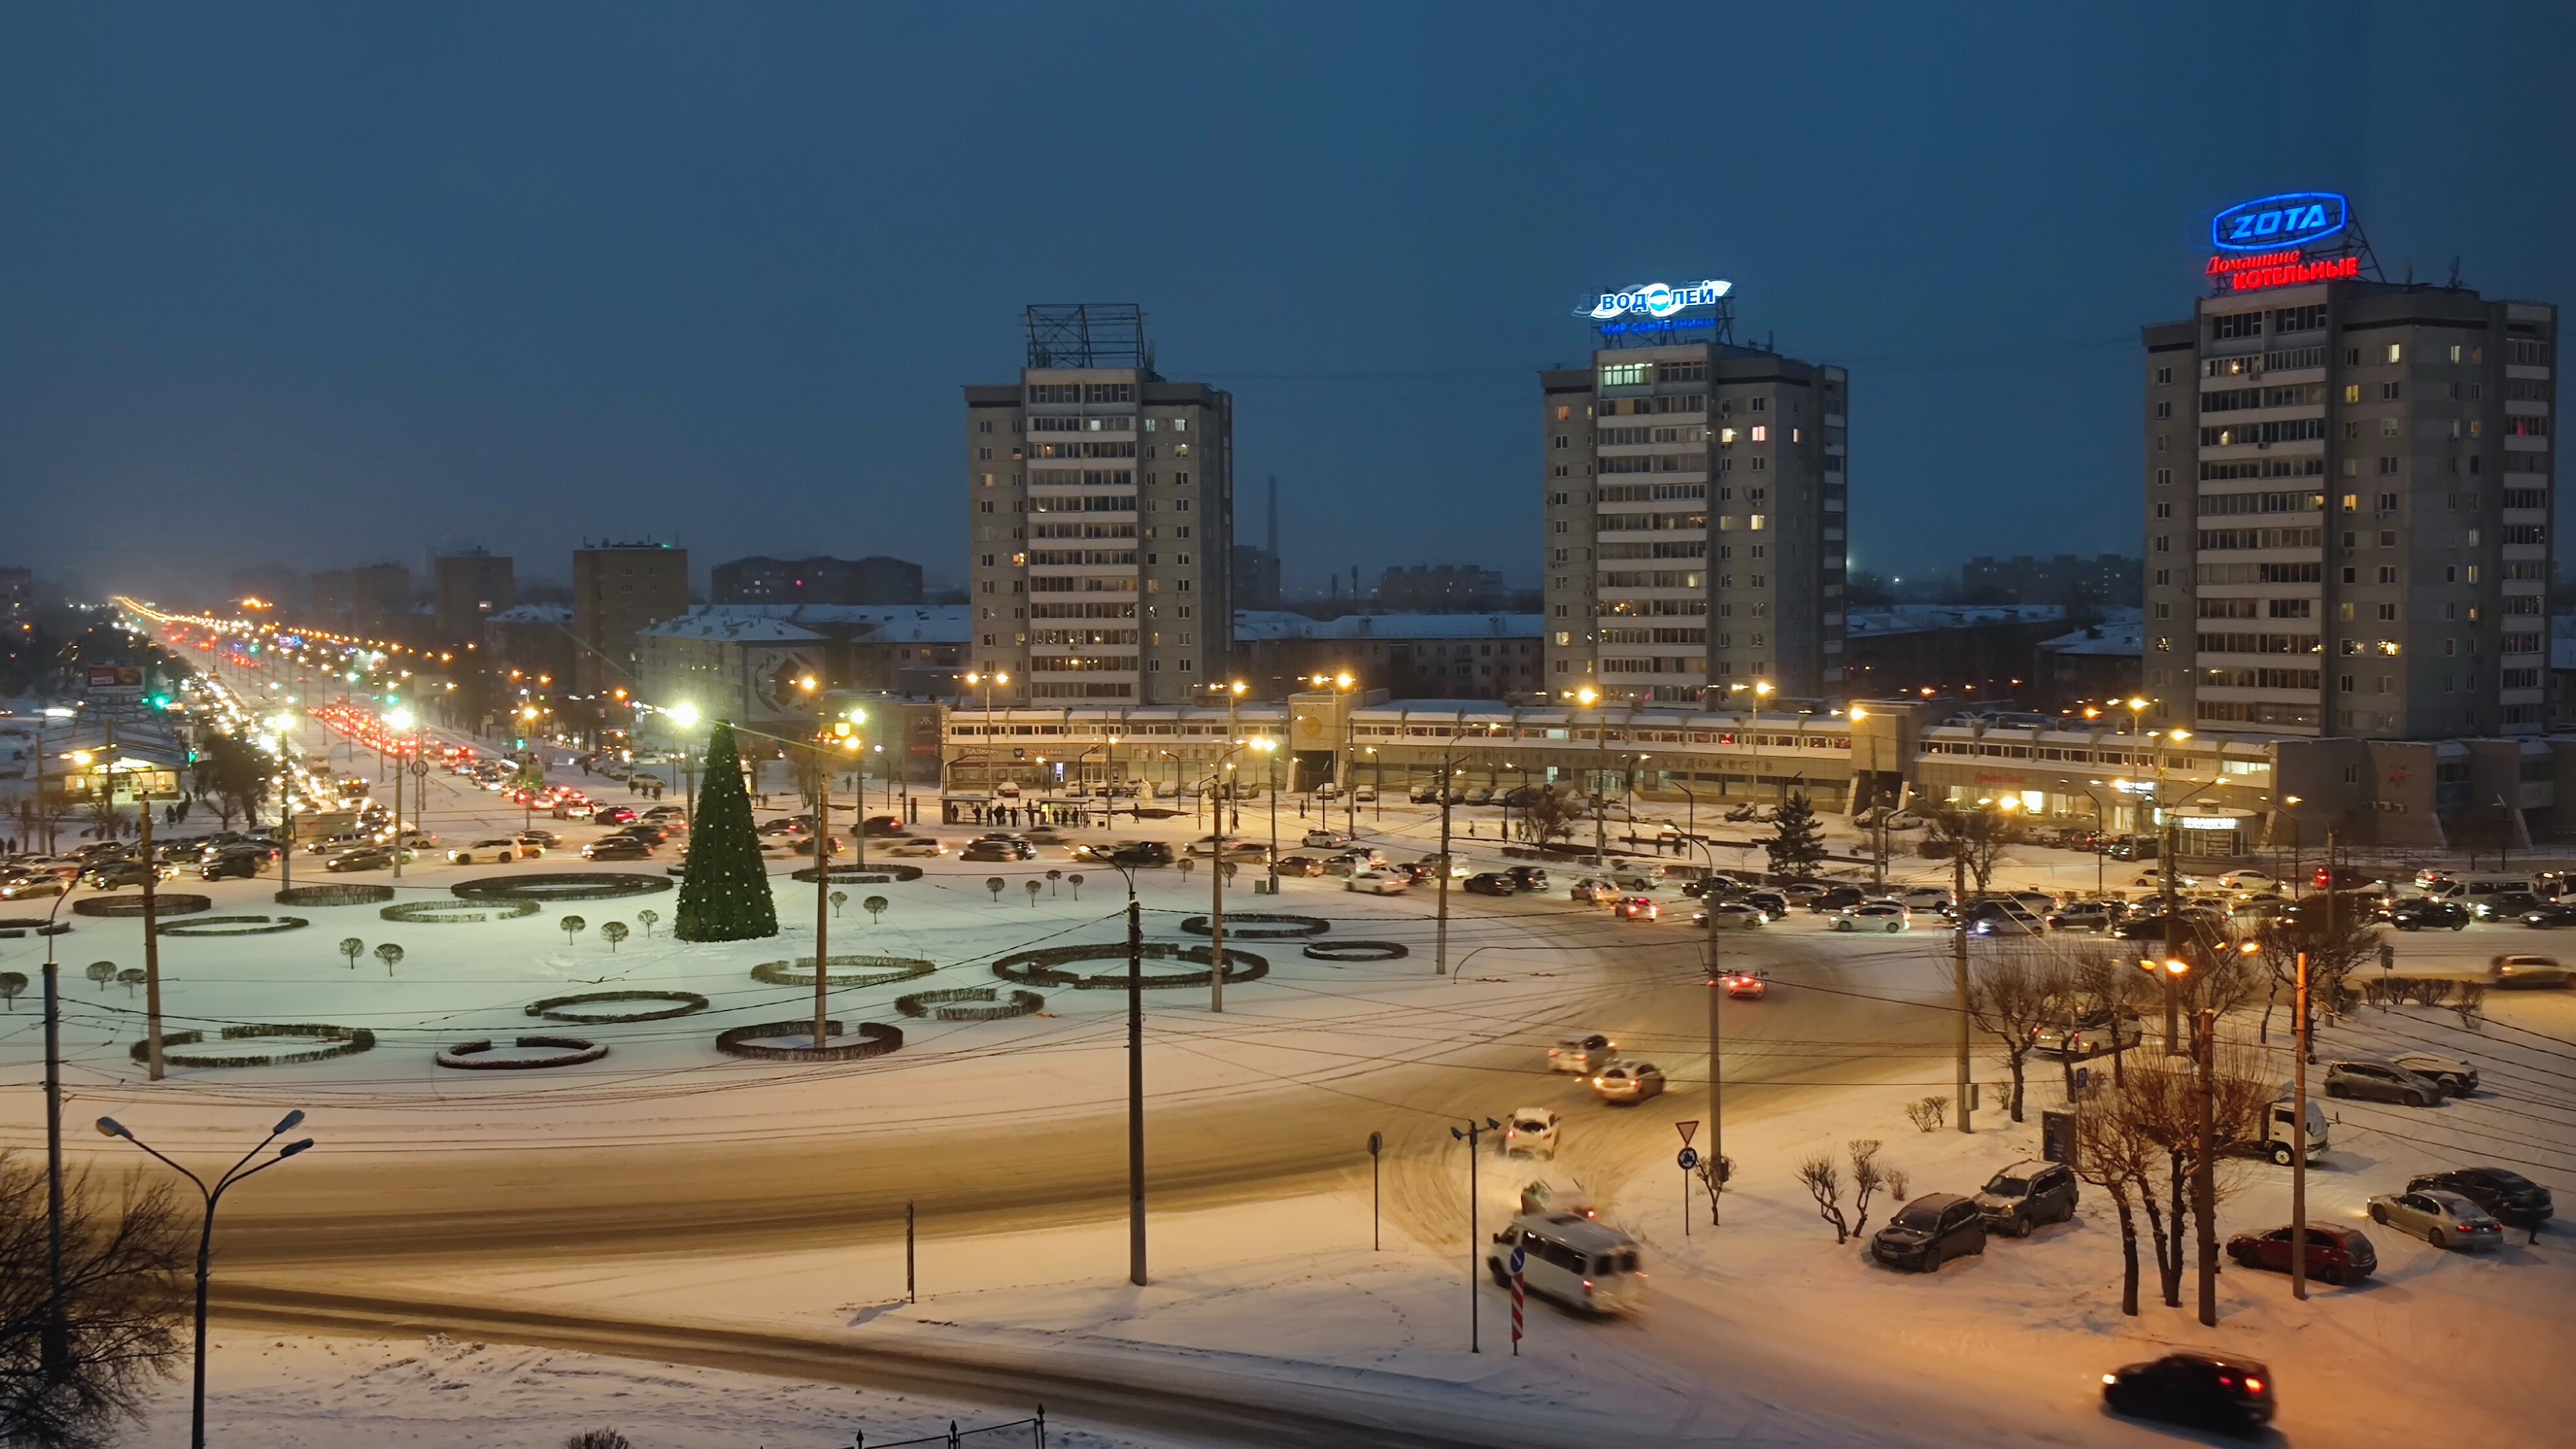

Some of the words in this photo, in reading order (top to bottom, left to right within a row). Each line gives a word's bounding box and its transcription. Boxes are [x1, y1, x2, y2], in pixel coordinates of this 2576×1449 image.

[2229, 204, 2327, 240] ZOTA
[2205, 249, 2303, 275] Домашние
[2233, 257, 2359, 291] КОТЕЛЬНЫЕ
[1601, 280, 1715, 312] ВОДОЛЕЙ
